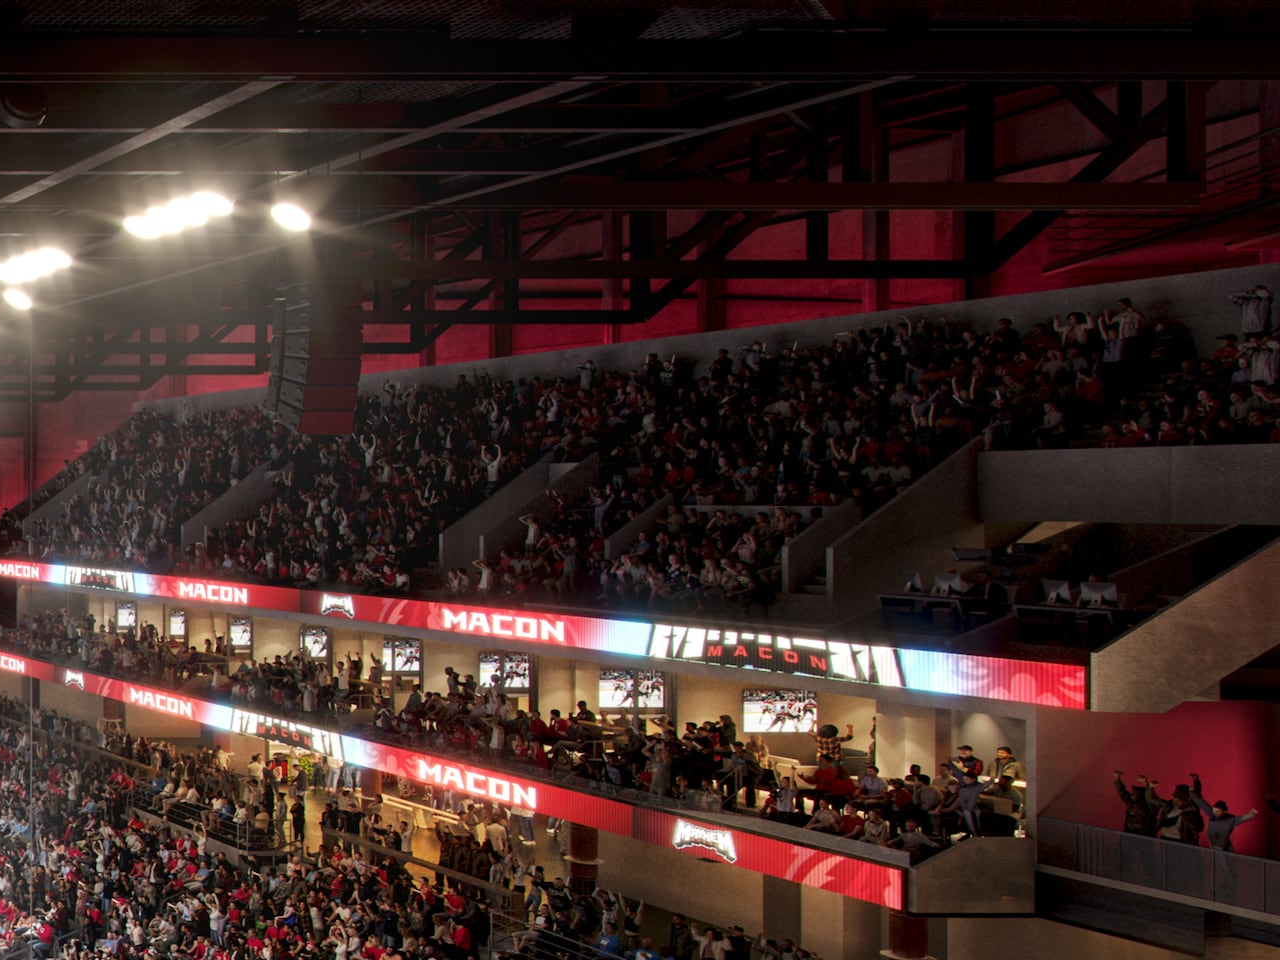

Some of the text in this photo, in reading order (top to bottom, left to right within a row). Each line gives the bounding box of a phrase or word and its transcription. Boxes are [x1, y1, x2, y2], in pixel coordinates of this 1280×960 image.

[179, 581, 248, 604] MACON
[442, 608, 565, 643] MACON
[706, 644, 828, 672] MACON
[130, 687, 193, 718] MACON
[257, 724, 313, 748] MACON
[418, 758, 537, 809] MACON
